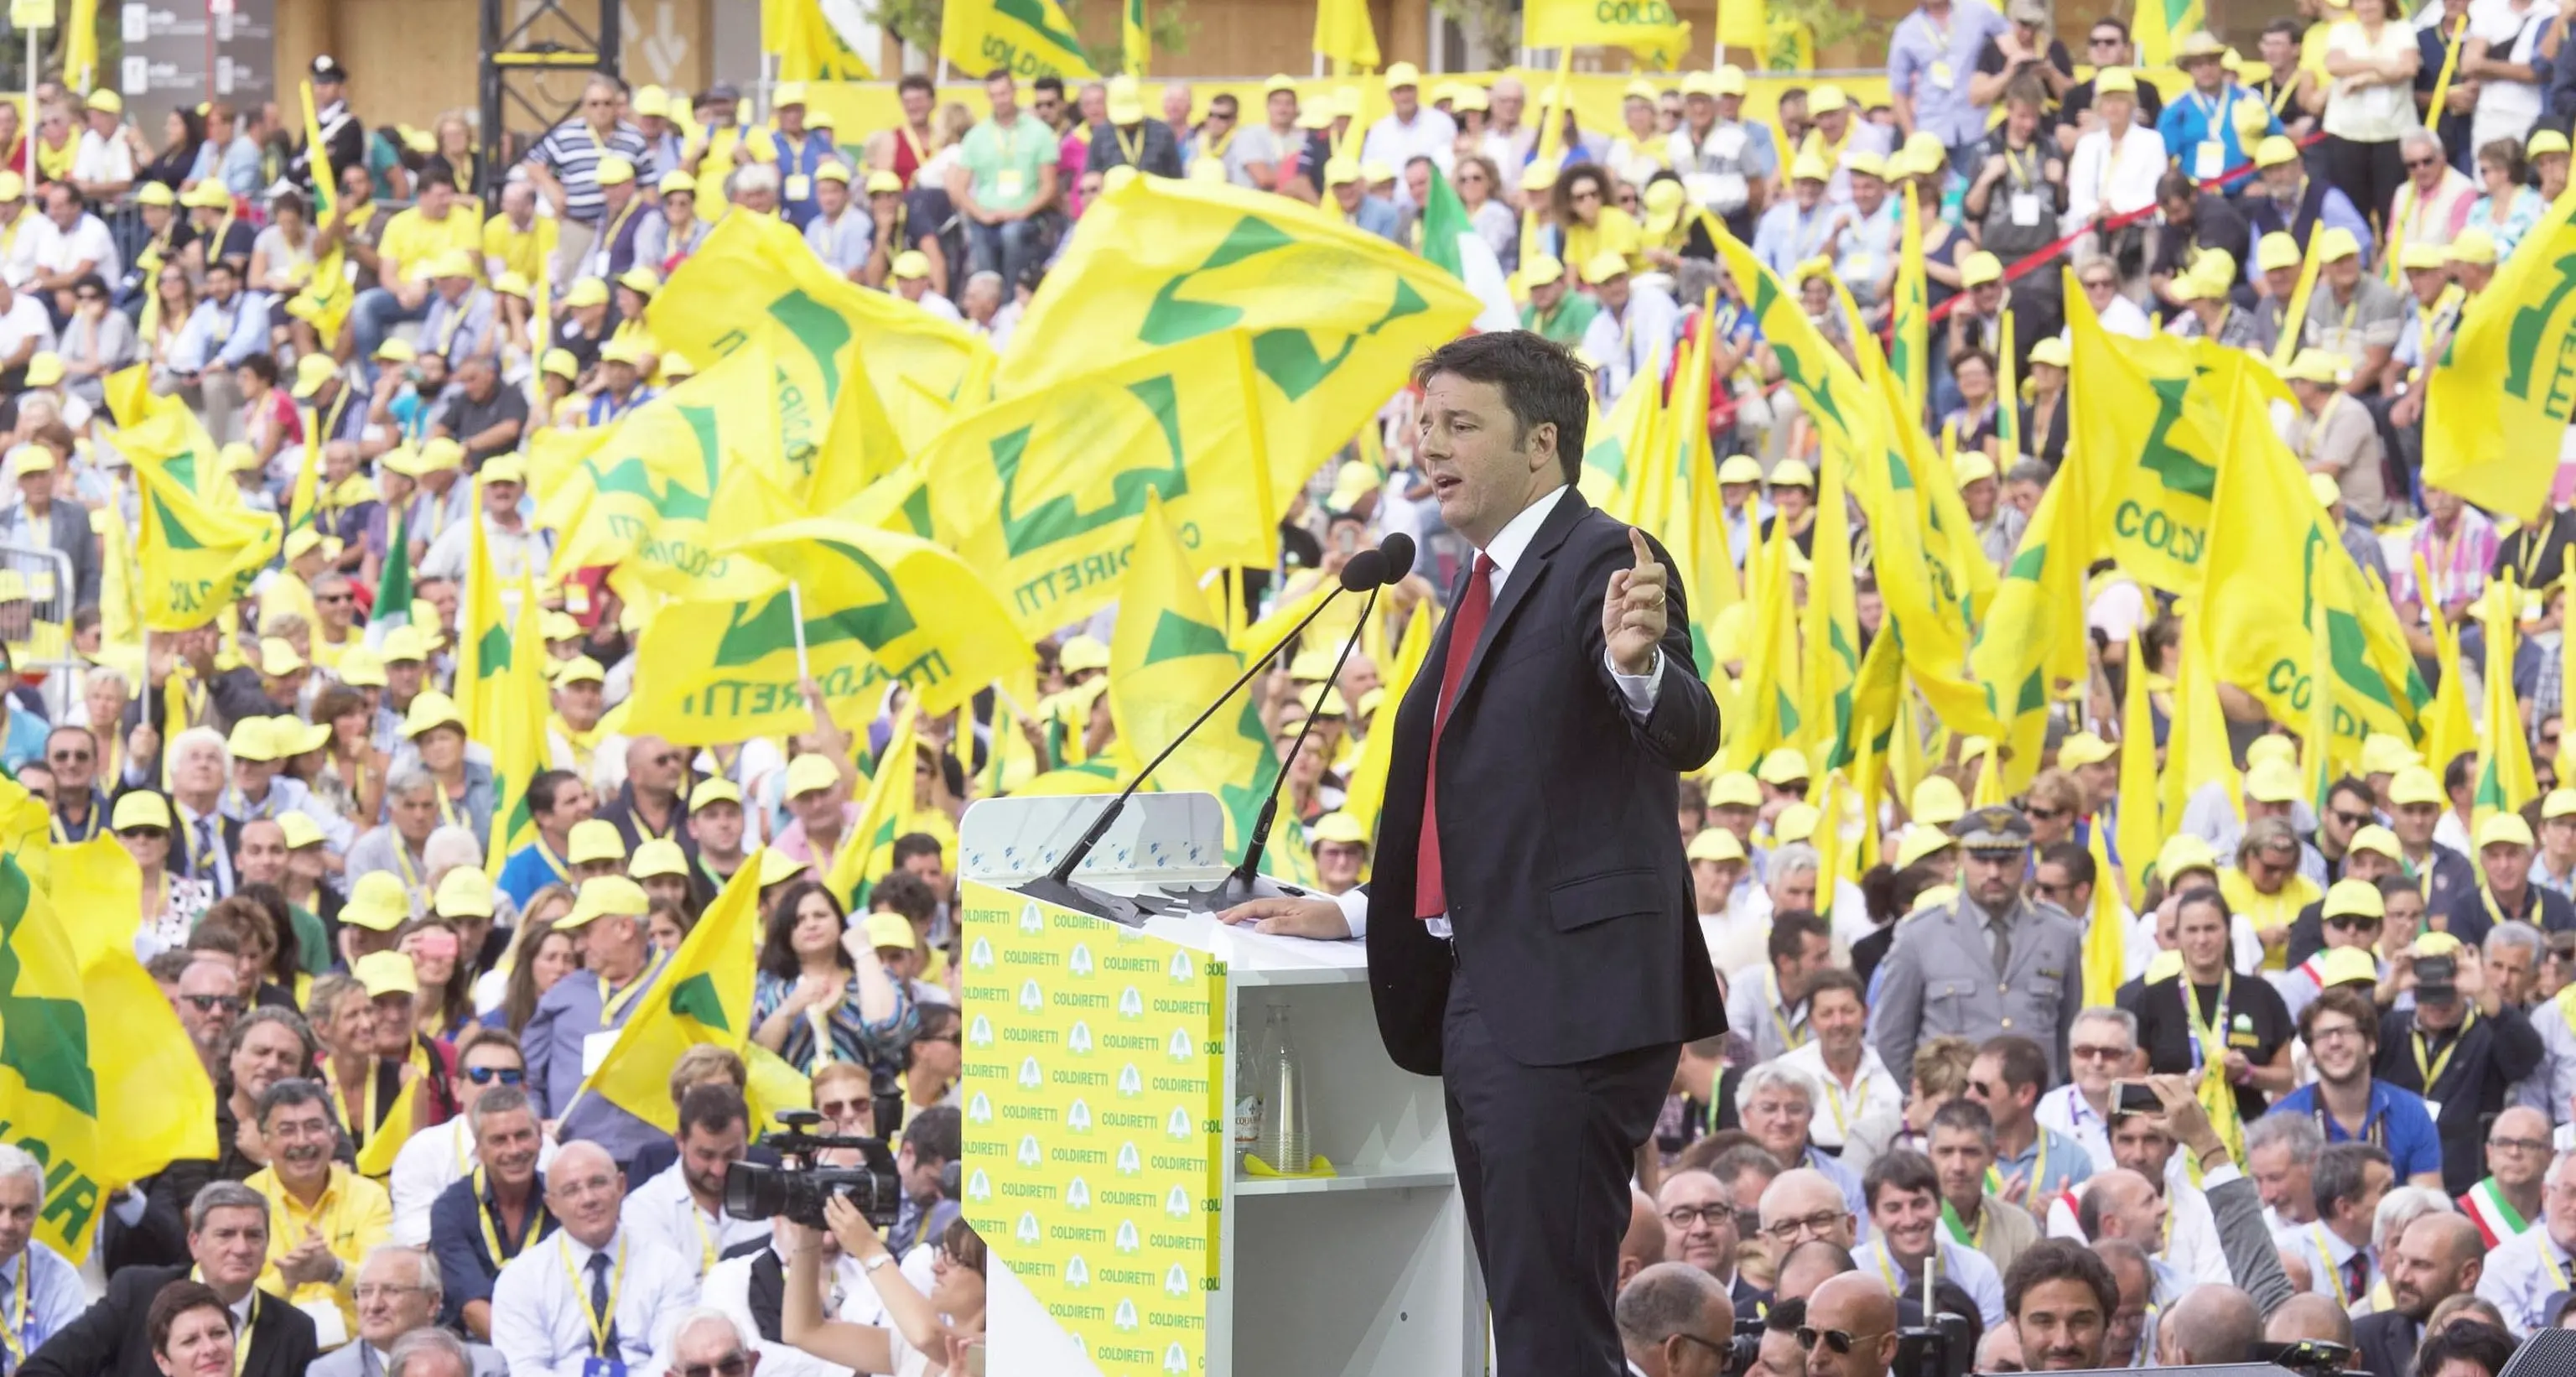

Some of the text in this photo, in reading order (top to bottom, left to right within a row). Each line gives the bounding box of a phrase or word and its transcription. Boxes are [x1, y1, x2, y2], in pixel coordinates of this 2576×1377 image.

[2267, 658, 2370, 741] CODI
[1004, 950, 1059, 966] COLDIRETTI
[1104, 957, 1159, 973] COLDIRETTI
[1205, 960, 1228, 976] COL
[1053, 992, 1109, 1008] COLDIRETTI
[1154, 999, 1210, 1016] COLDIRETTI
[1004, 1027, 1058, 1043] COLDIRETTI
[1103, 1035, 1158, 1051] COLDIRETTI
[1203, 1041, 1225, 1055] COL
[1052, 1070, 1108, 1086] COLDIRETTI
[1152, 1077, 1208, 1094] COLDIRETTI
[1002, 1105, 1057, 1121] COLDIRETTI
[1102, 1113, 1157, 1130] COLDIRETTI
[1202, 1119, 1223, 1133] COL
[1052, 1147, 1107, 1164] COLDIRETTI
[1150, 1156, 1207, 1172] COLDIRETTI
[1002, 1182, 1057, 1199] COLDIRETTI
[1100, 1191, 1156, 1208] COLDIRETTI
[1200, 1198, 1222, 1212] COL
[1050, 1225, 1106, 1242] COLDIRETTI
[1150, 1233, 1206, 1250] COLDIRETTI
[1099, 1268, 1156, 1286] COLDIRETTI
[1199, 1276, 1221, 1291] COL
[1049, 1303, 1104, 1320] COLDIRETTI
[1149, 1312, 1204, 1330] COLDIRETTI
[1098, 1346, 1154, 1364] COLDIRETTI
